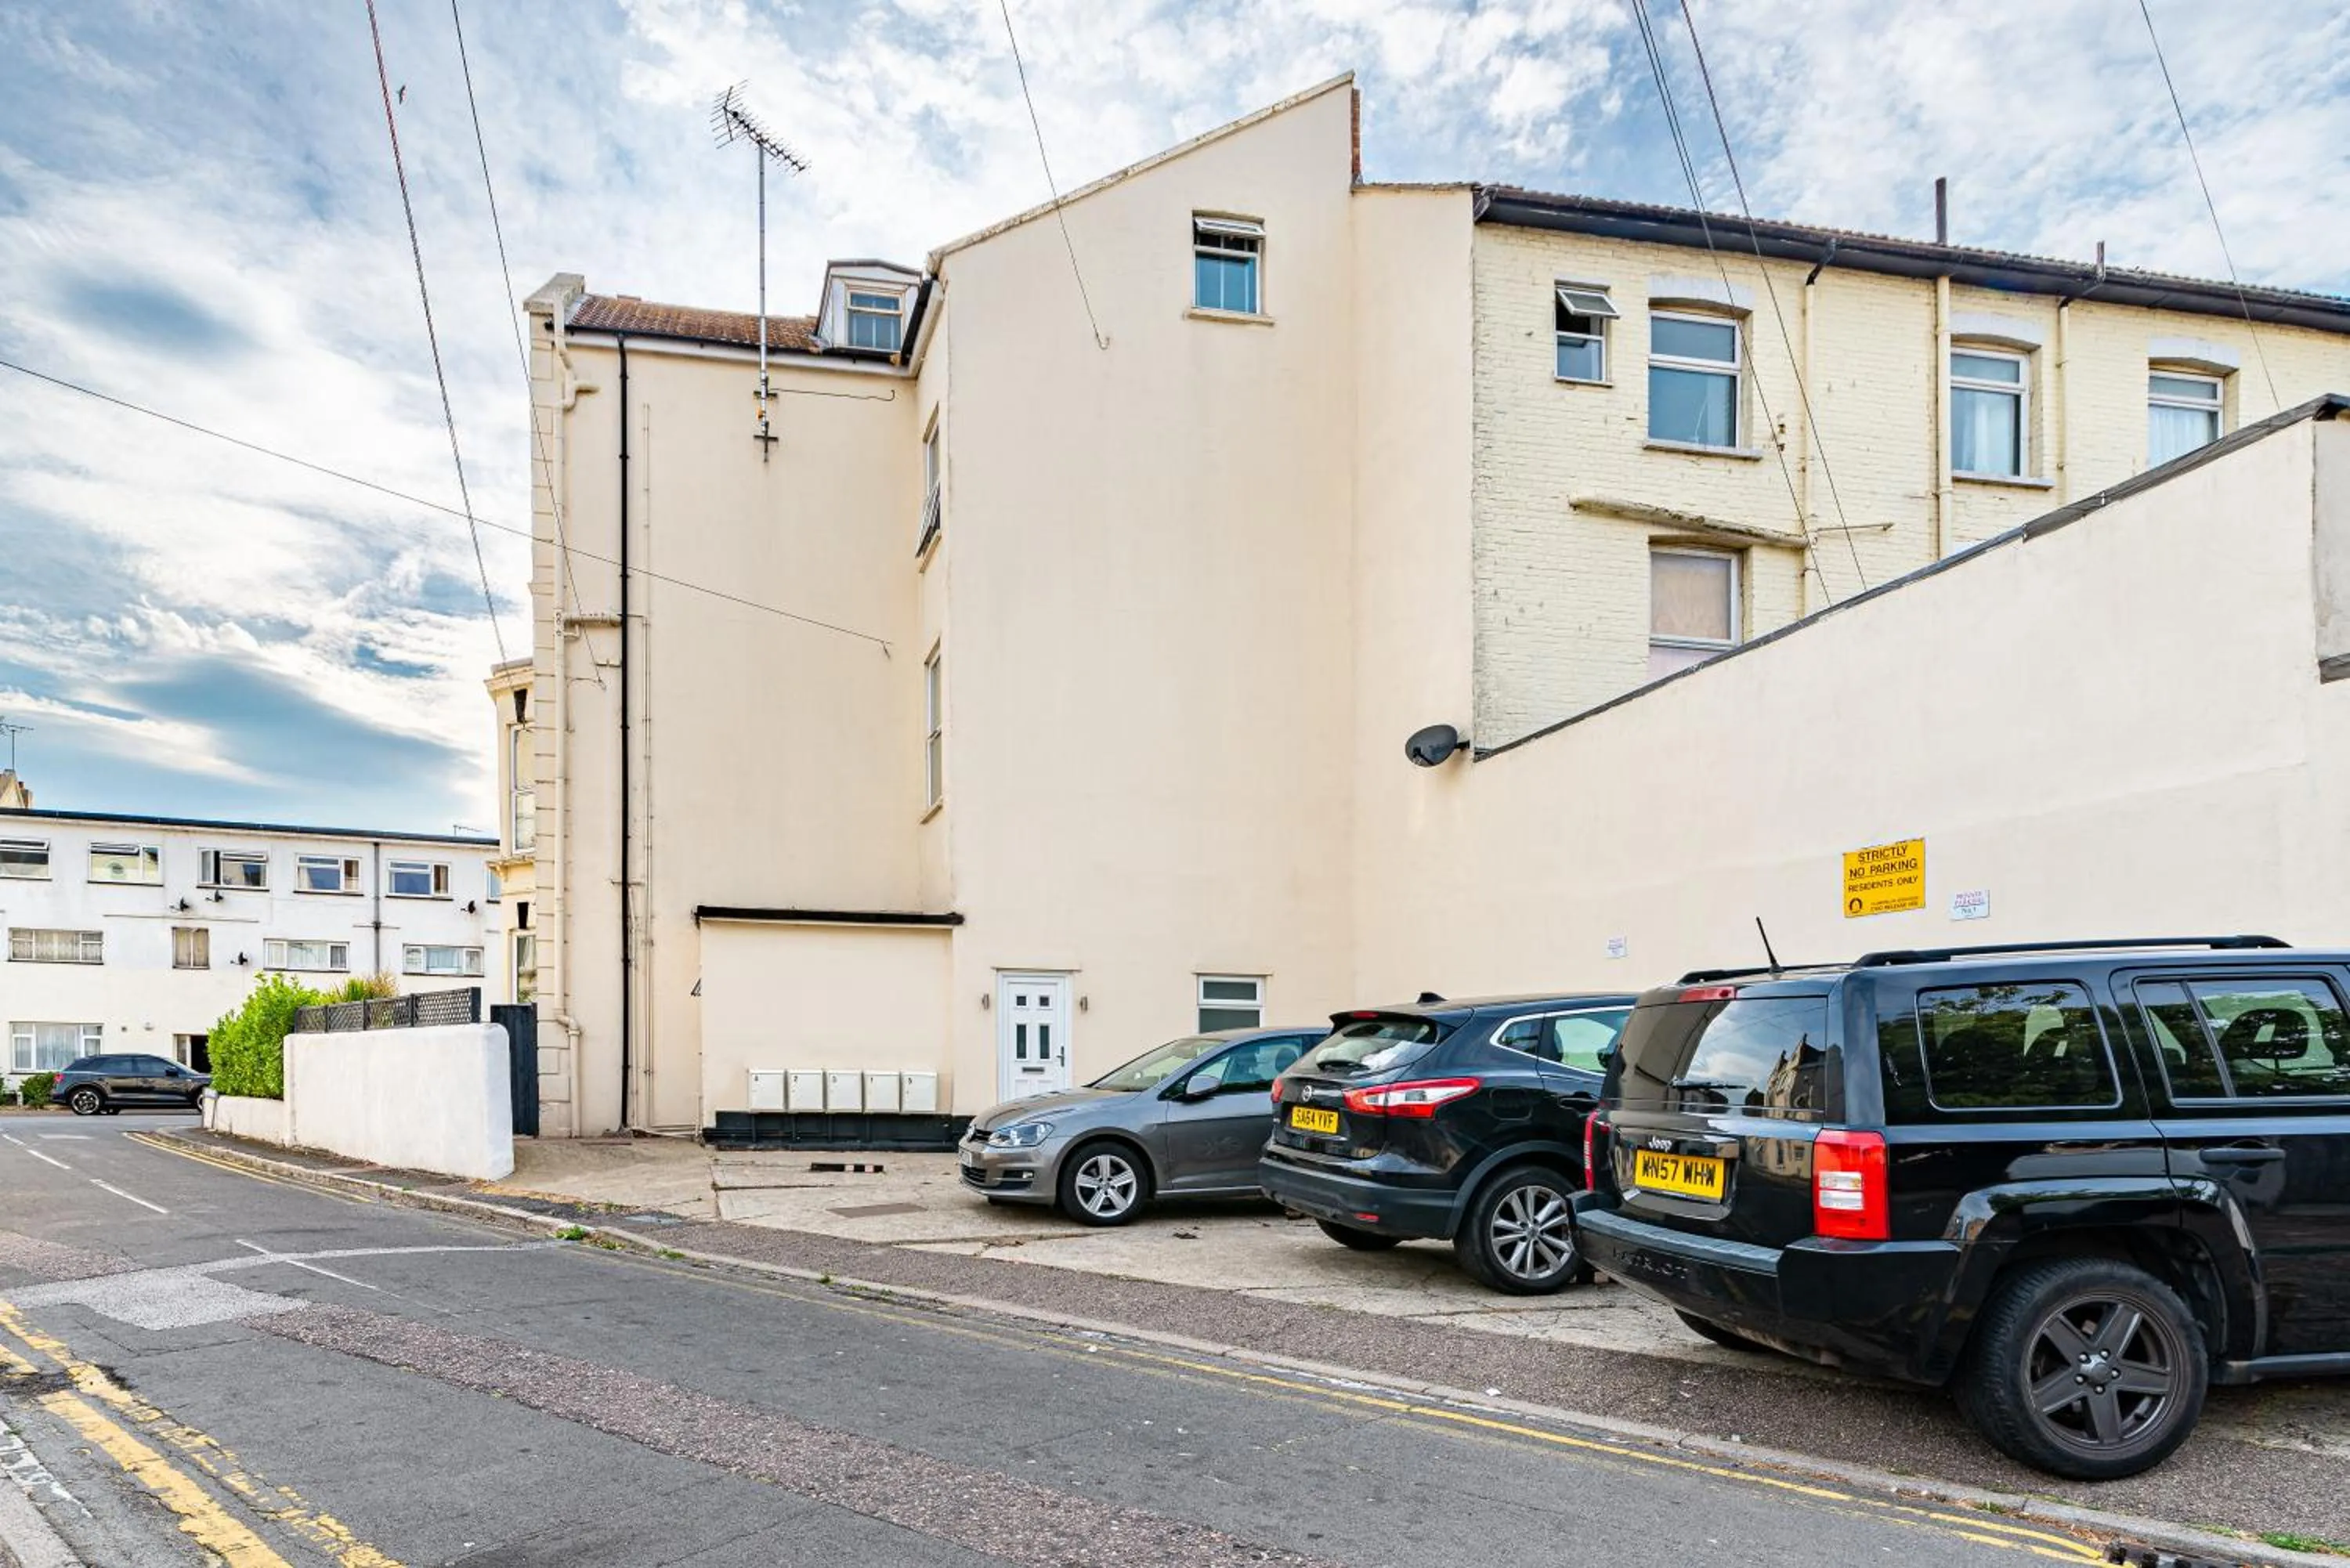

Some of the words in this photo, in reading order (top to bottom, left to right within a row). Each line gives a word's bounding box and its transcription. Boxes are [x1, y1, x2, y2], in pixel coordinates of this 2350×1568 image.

[1857, 845, 1907, 862] STRICTLY
[1849, 867, 1865, 878] NO
[1870, 858, 1918, 875] PARKING
[1849, 879, 1893, 892] RESIDENTS
[1896, 875, 1918, 886] ONLY
[1318, 1111, 1334, 1129] YVF
[1649, 1136, 1672, 1152] Jeep
[1642, 1155, 1679, 1182] WN57
[1683, 1160, 1716, 1187] WHW
